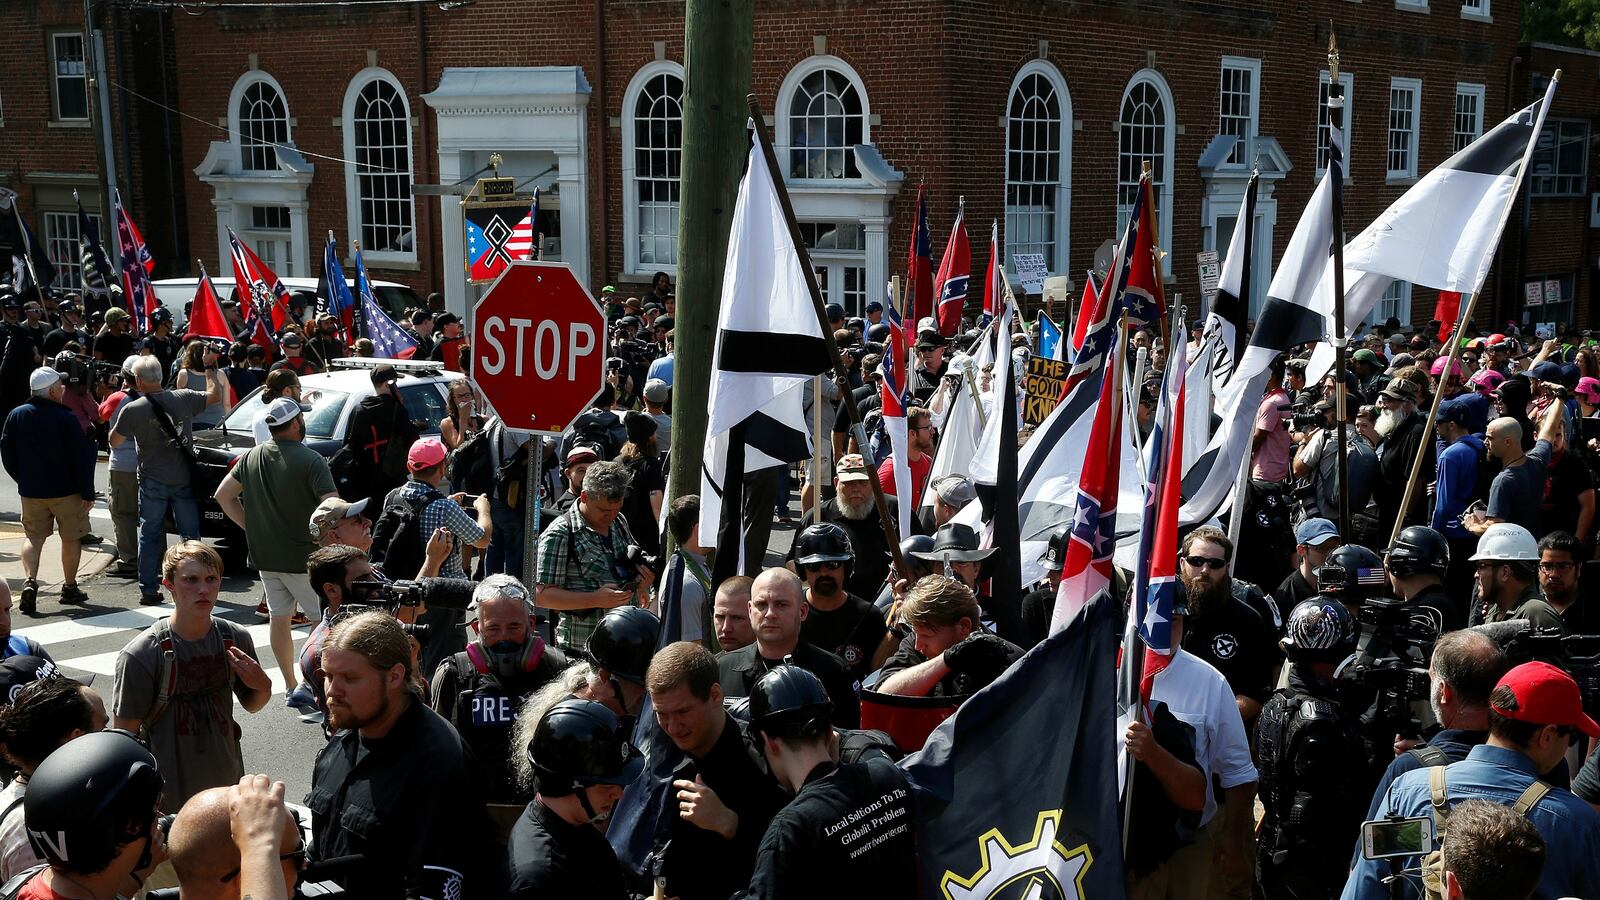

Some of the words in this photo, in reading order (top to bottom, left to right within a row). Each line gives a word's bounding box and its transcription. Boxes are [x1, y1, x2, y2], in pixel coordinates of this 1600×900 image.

[481, 316, 596, 381] STOP
[1032, 358, 1066, 377] THE
[1026, 396, 1058, 424] KNO
[824, 817, 849, 837] Local
[880, 794, 893, 805] To
[892, 788, 907, 799] The
[871, 806, 906, 828] Problem
[28, 826, 69, 862] TV
